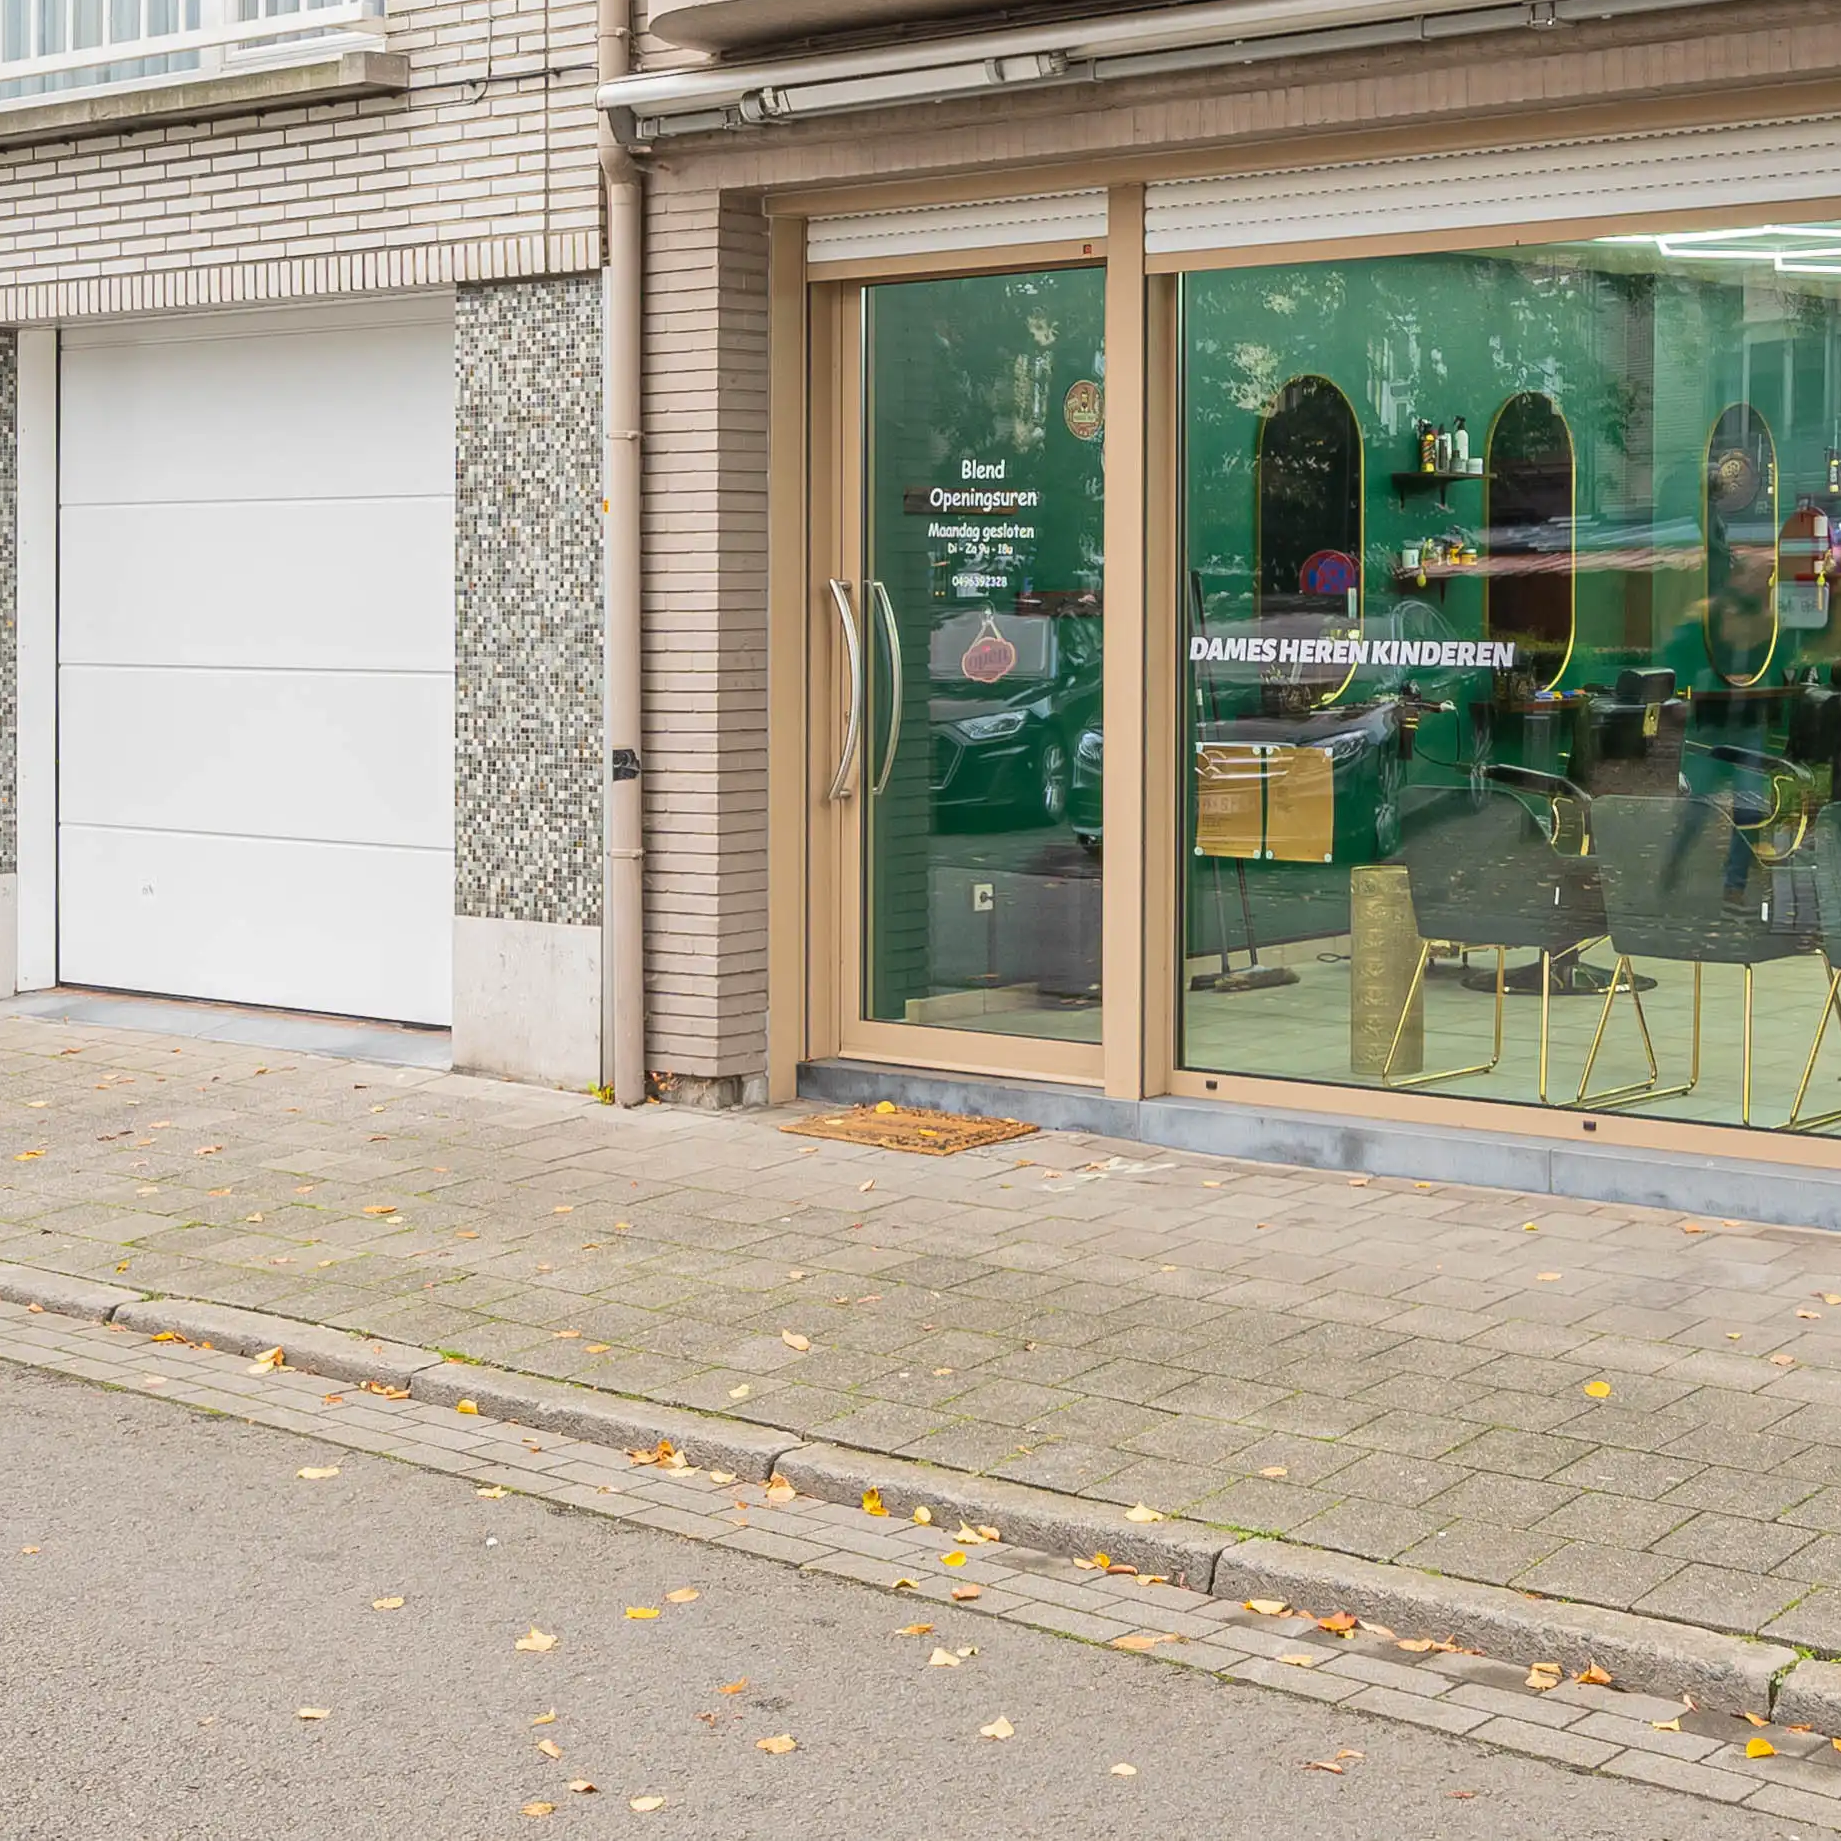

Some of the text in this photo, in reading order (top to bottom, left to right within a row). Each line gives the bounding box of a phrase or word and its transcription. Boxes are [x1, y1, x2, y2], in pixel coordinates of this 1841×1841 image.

[961, 458, 1006, 479] Blend
[929, 487, 1038, 512] Openingsuren
[928, 522, 1035, 542] Maandag gesloten
[947, 542, 958, 554] Di
[965, 542, 977, 554] Za
[1189, 636, 1515, 667] DAMES HEREN KINDEREN
